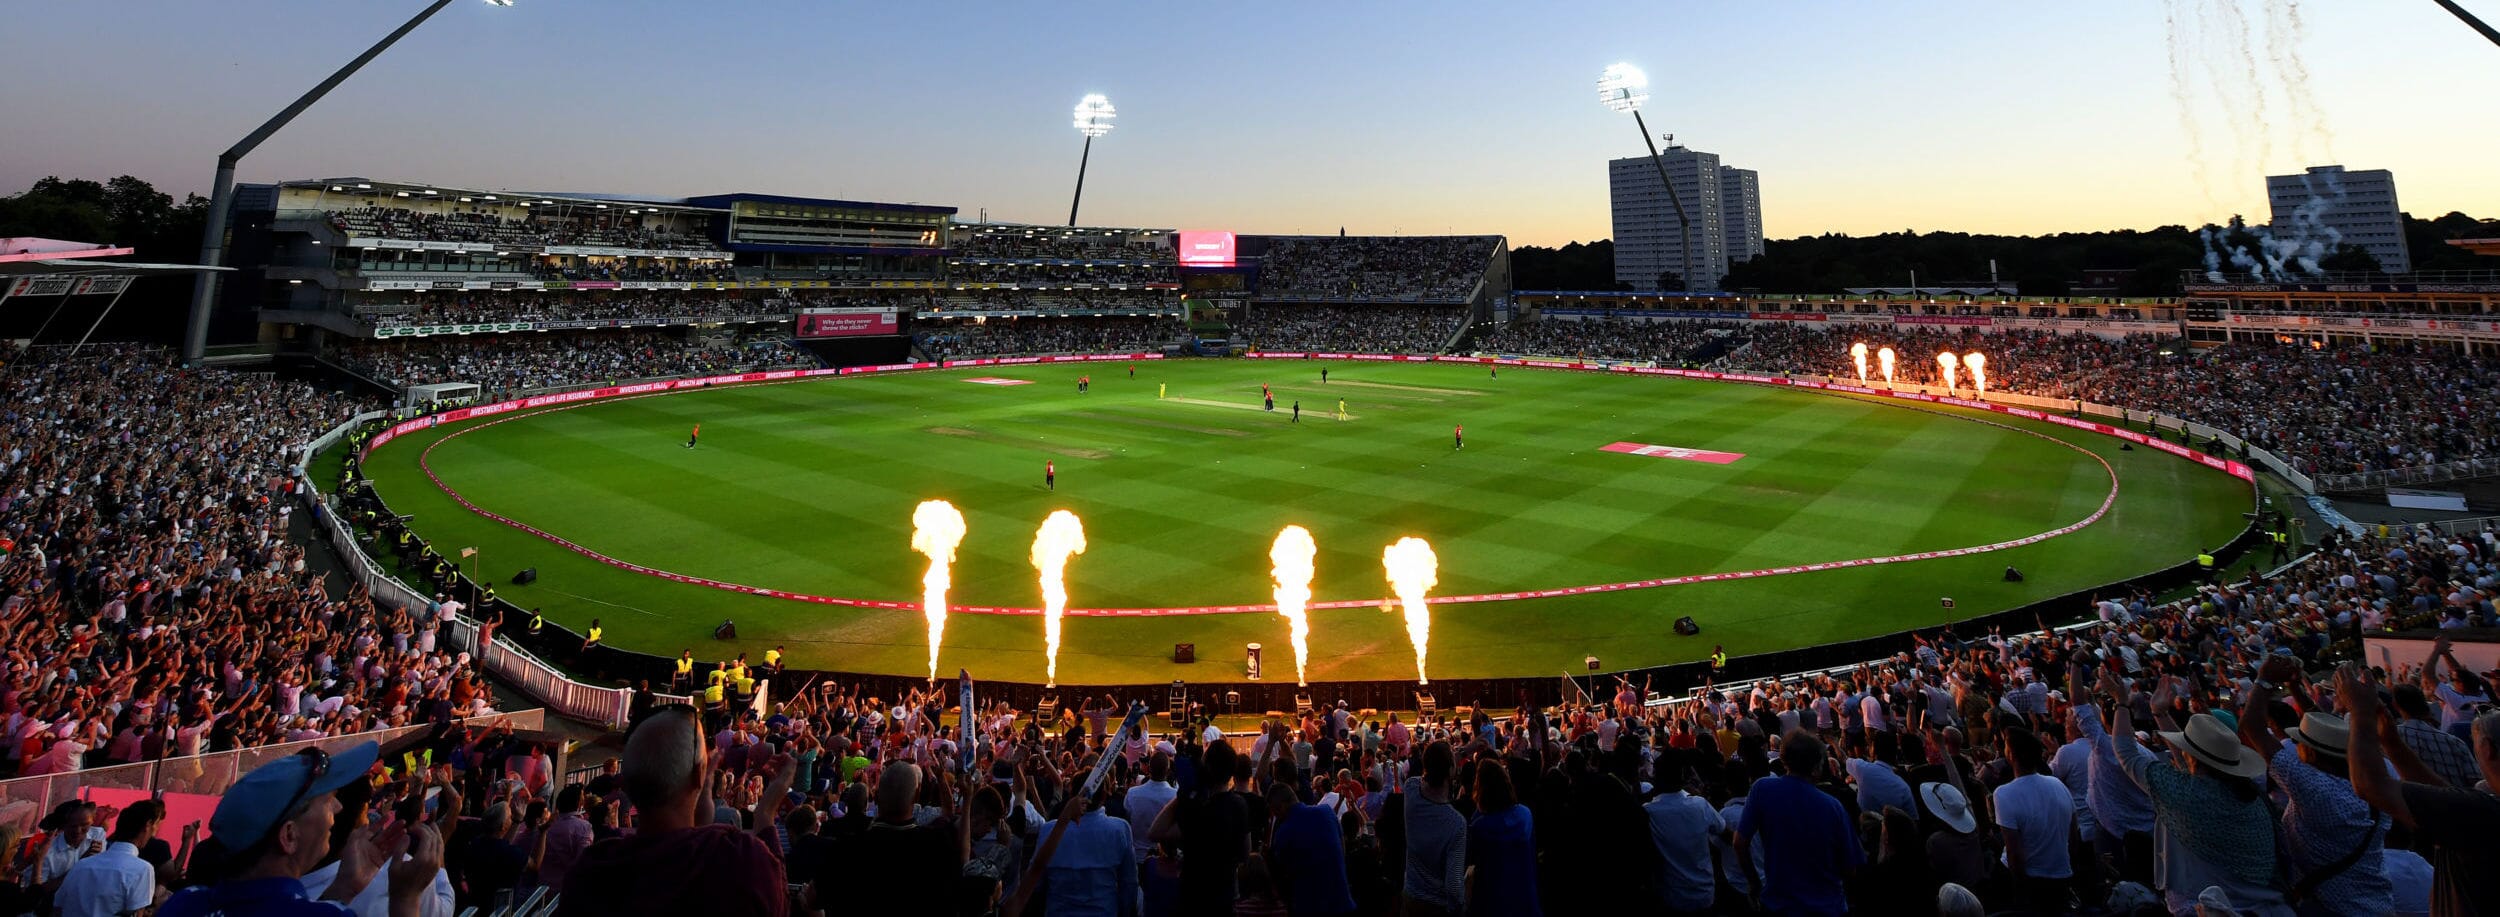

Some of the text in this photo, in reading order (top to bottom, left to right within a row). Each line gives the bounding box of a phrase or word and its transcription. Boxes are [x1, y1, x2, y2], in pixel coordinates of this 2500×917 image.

[1218, 300, 1241, 308] UNIBET
[678, 379, 695, 387] HEALTH
[718, 375, 742, 383] INSURANCE
[528, 397, 545, 407] HEALTH
[545, 395, 556, 404] AND
[557, 394, 567, 402] LIFE
[567, 391, 594, 402] INSURANCE
[619, 384, 652, 394] INVESTMENTS
[1893, 391, 1919, 399] INVESTMENTS
[470, 405, 502, 416] INVESTMENTS
[1971, 401, 1991, 410] INSURANCE
[2008, 407, 2030, 416] INVESTMENTS
[2048, 414, 2060, 422] HEALTH
[2060, 416, 2068, 424] AND
[2076, 418, 2096, 430] INSURANCE
